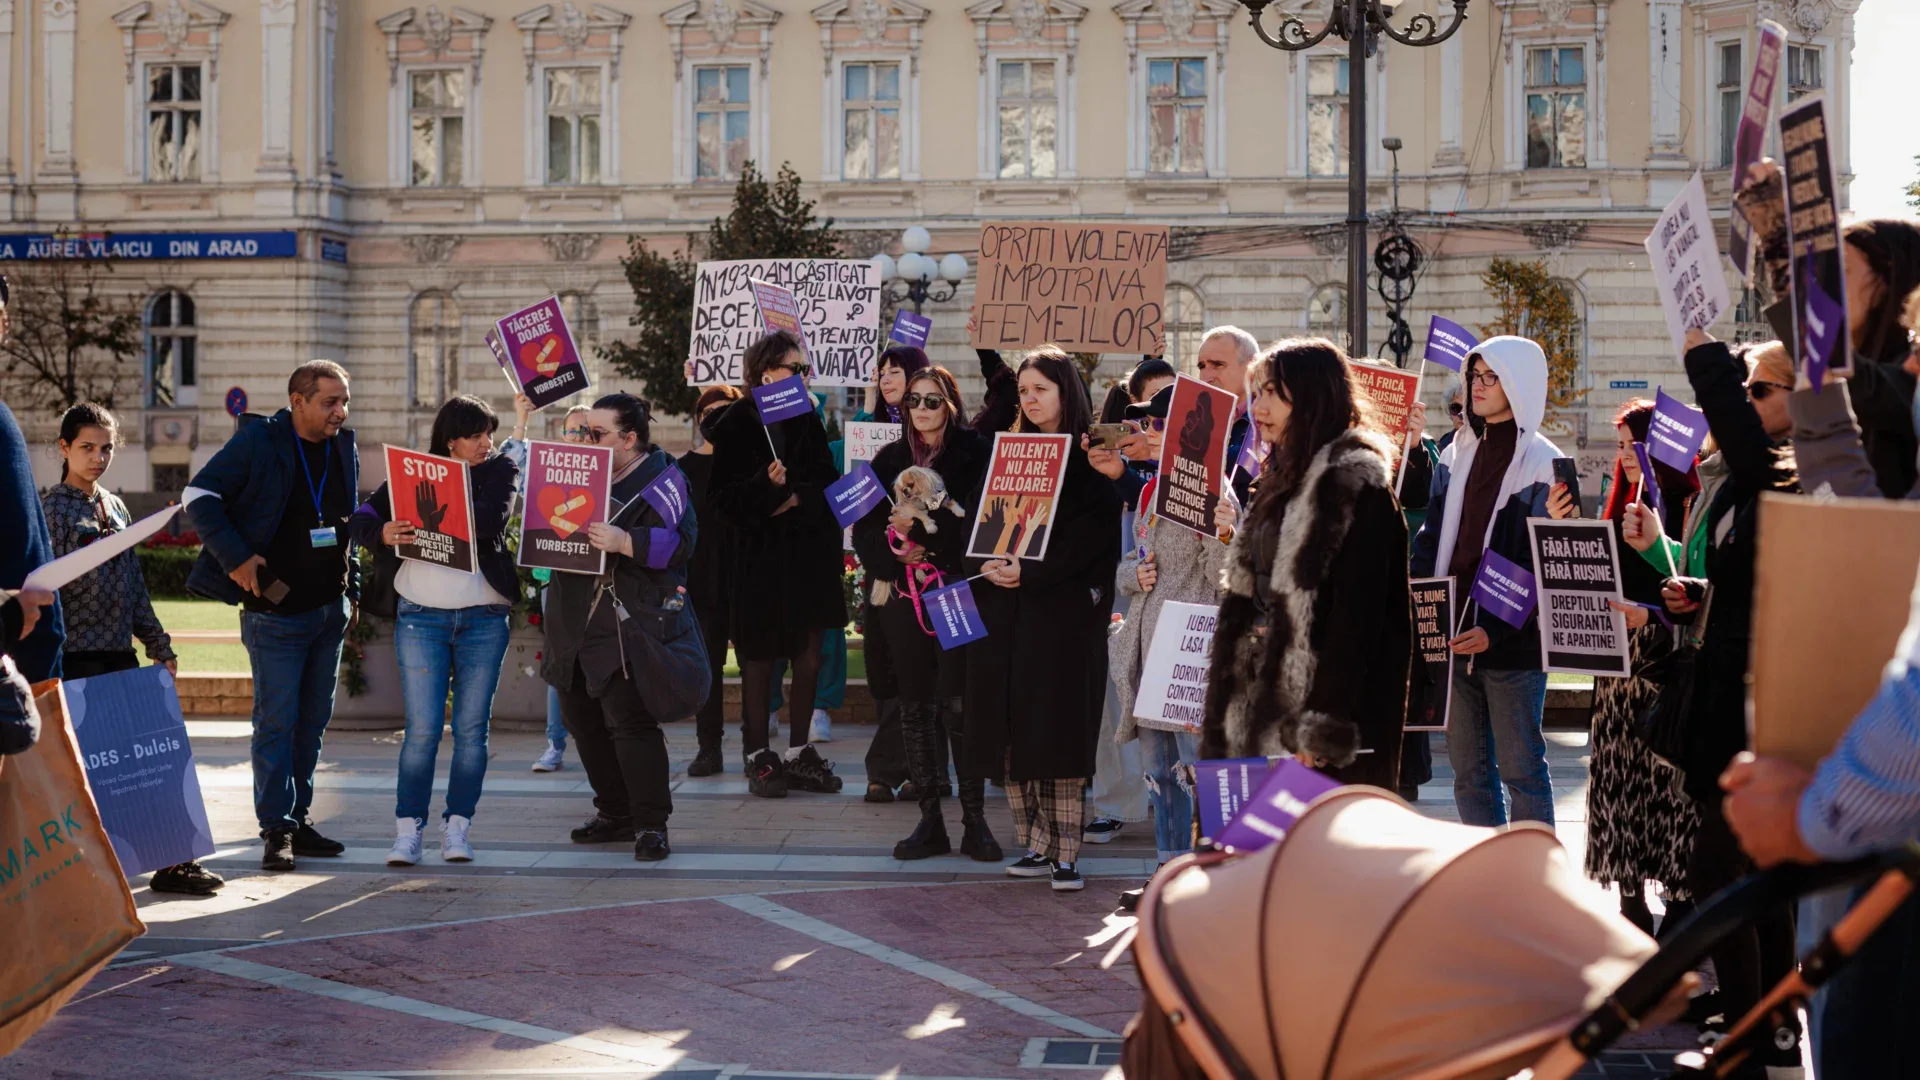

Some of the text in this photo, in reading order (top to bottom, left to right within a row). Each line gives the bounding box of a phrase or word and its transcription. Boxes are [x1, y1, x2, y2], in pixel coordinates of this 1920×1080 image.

[27, 241, 85, 258] AUREL
[88, 241, 153, 257] VLAICU
[169, 240, 199, 256] DIN
[207, 240, 259, 256] ARAD
[1065, 229, 1168, 268] VIOLENȚA
[763, 261, 793, 284] AM
[991, 261, 1146, 302] ÎMPOTRIVA
[844, 285, 880, 303] VOT
[506, 306, 554, 335] TĂCEREA
[517, 320, 553, 345] DOARE
[979, 302, 1162, 352] FEMEILOR
[820, 326, 878, 345] PENTRU
[533, 370, 576, 395] VORBEȘTE!
[1376, 376, 1407, 395] FRICĂ,
[538, 448, 599, 471] TĂCEREA
[1000, 442, 1058, 462] VIOLENȚA
[403, 456, 449, 482] STOP
[545, 467, 591, 487] DOARE
[1005, 460, 1049, 476] NU ARE
[1173, 454, 1209, 480] VIOLENȚA
[835, 474, 871, 503] ÎMPREUNĂ
[992, 476, 1054, 492] CULOARE!
[1169, 467, 1209, 496] ÎN FAMILIE
[1169, 485, 1206, 511] DISTRUGE
[1165, 499, 1207, 527] GENERAȚII.
[420, 549, 450, 564] ACUM!
[535, 537, 590, 556] VORBEȘTE!
[1542, 536, 1610, 560] FĂRĂ FRICĂ,
[1484, 564, 1531, 598] ÎMPREUNĂ
[1543, 560, 1615, 584] FĂRĂ RUȘINE,
[1424, 589, 1446, 603] NUME
[1551, 594, 1612, 613] DREPTUL LA
[937, 593, 960, 638] ÎMPREUNĂ
[1552, 612, 1614, 635] SIGURANȚĂ
[1180, 635, 1205, 653] LASA
[1552, 631, 1617, 651] NE APARȚINE!
[133, 736, 180, 760] Dulcis
[1216, 767, 1232, 827] PREUNĂ
